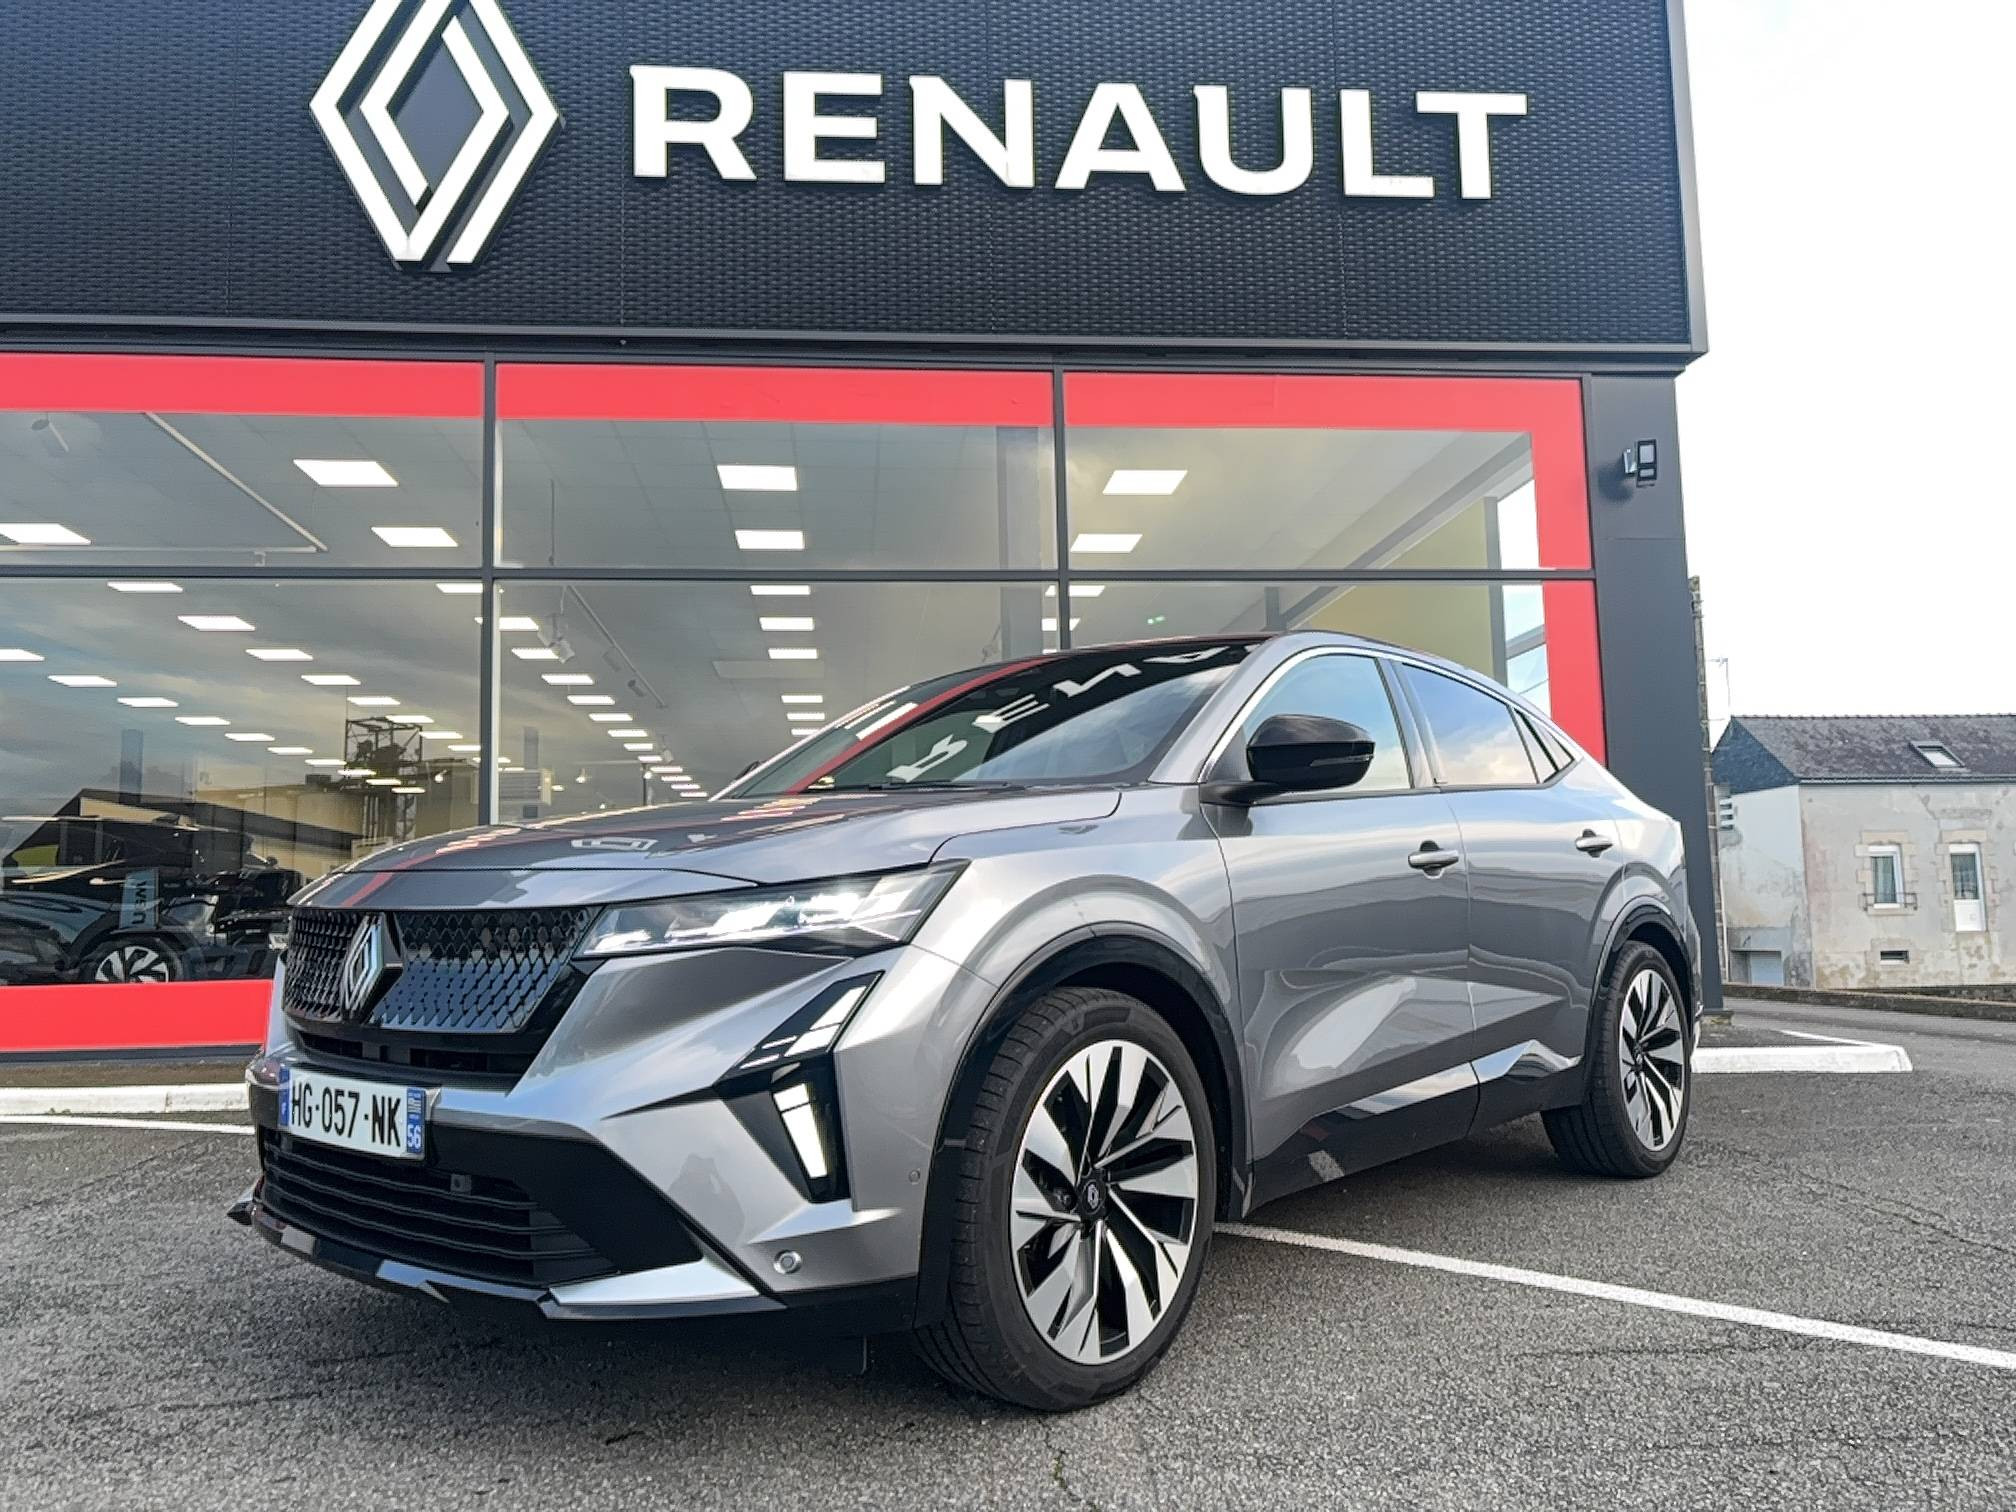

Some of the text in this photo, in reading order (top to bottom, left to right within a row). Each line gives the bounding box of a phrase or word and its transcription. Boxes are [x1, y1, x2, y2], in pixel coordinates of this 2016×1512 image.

[630, 65, 1526, 198] RENAULT
[291, 1081, 402, 1148] HG-057-NK
[407, 1123, 421, 1150] 56
